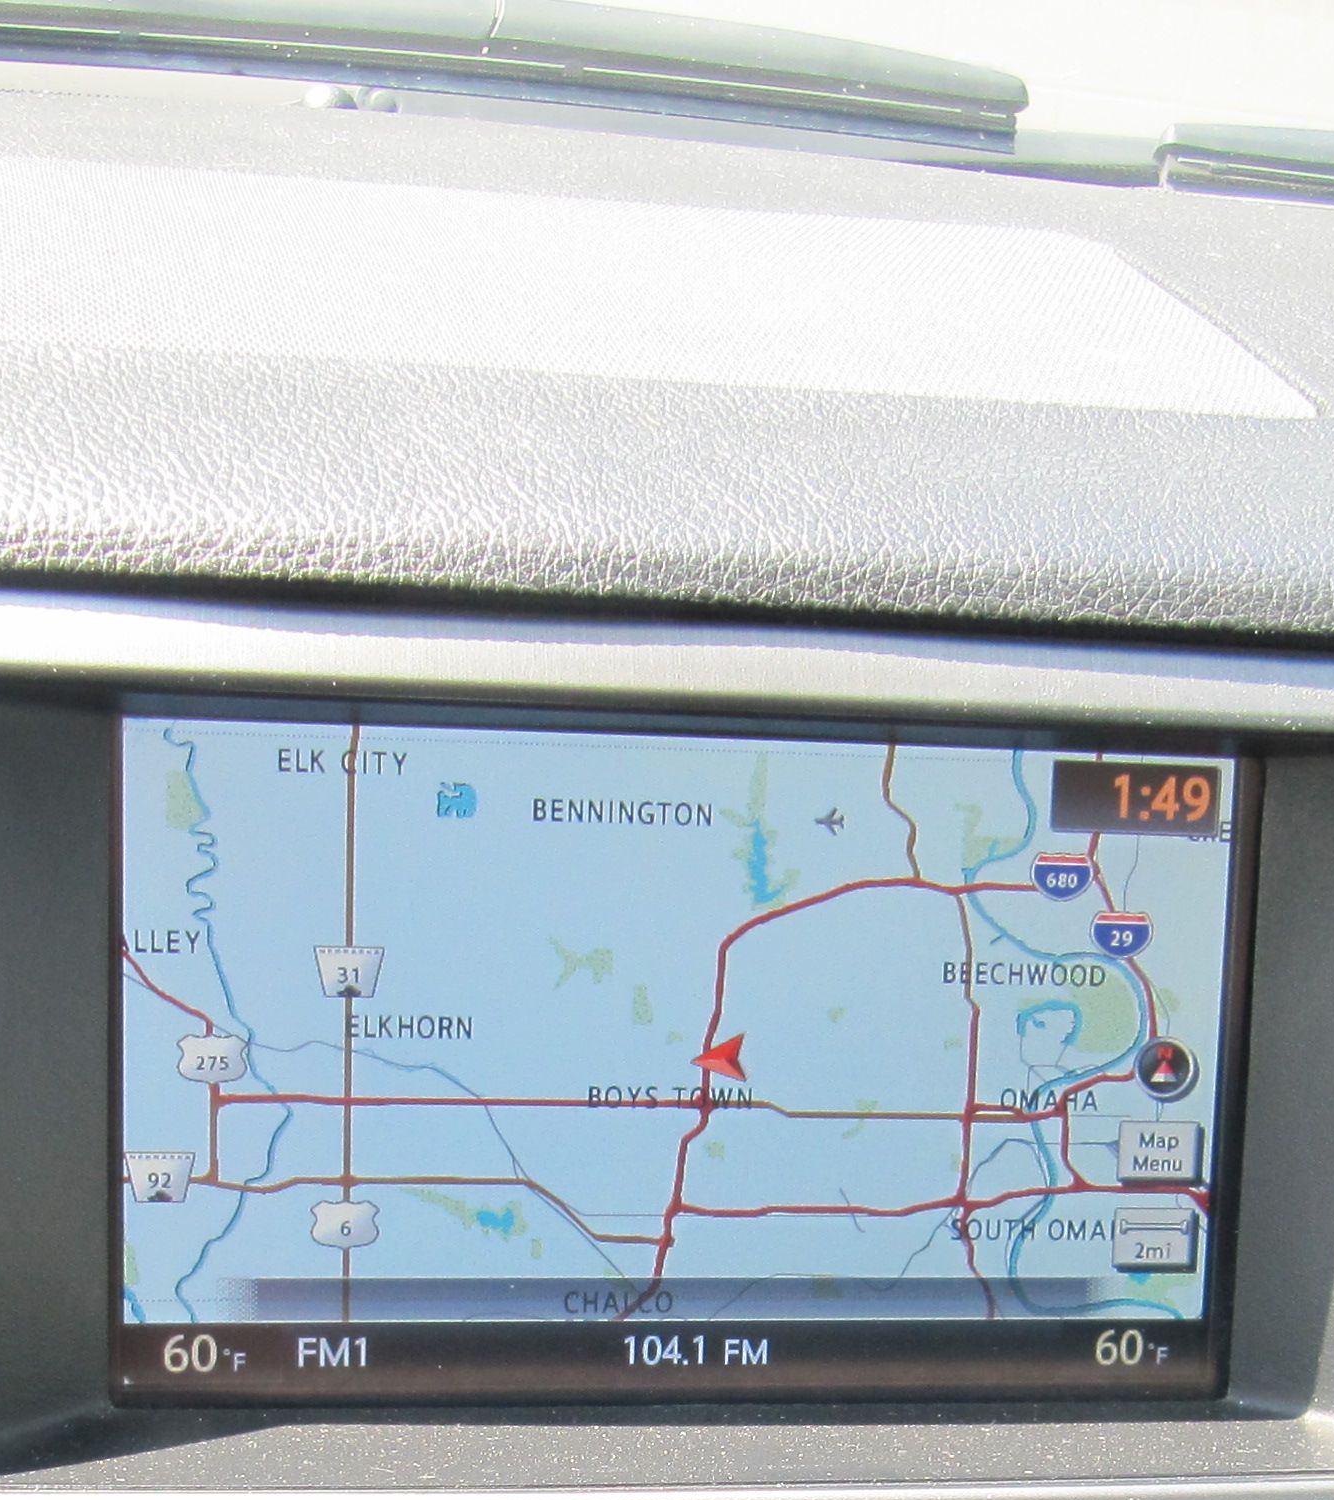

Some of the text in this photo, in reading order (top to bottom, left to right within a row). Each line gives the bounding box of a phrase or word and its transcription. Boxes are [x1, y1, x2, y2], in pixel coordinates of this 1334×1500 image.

[278, 748, 409, 776] ELK CITY
[1112, 772, 1212, 823] 1:49
[531, 797, 714, 828] BENNINGTON
[1045, 870, 1079, 890] 680
[124, 929, 201, 954] LLEY
[1109, 929, 1134, 949] 29
[336, 966, 361, 985] 31
[942, 961, 1107, 988] BEECHWOOD
[348, 1014, 474, 1040] ELKHORN
[195, 1054, 230, 1072] 275
[588, 1085, 659, 1108] BOYS
[999, 1088, 1098, 1112] OMAHA
[1138, 1132, 1179, 1151] Map
[1132, 1155, 1183, 1173] Menu
[147, 1171, 172, 1189] 92
[339, 1219, 352, 1237] 6
[951, 1218, 1116, 1241] SOUTH OMA
[1134, 1242, 1172, 1259] 2mi
[297, 1337, 369, 1368] FM1
[624, 1334, 770, 1366] 104.1 FM
